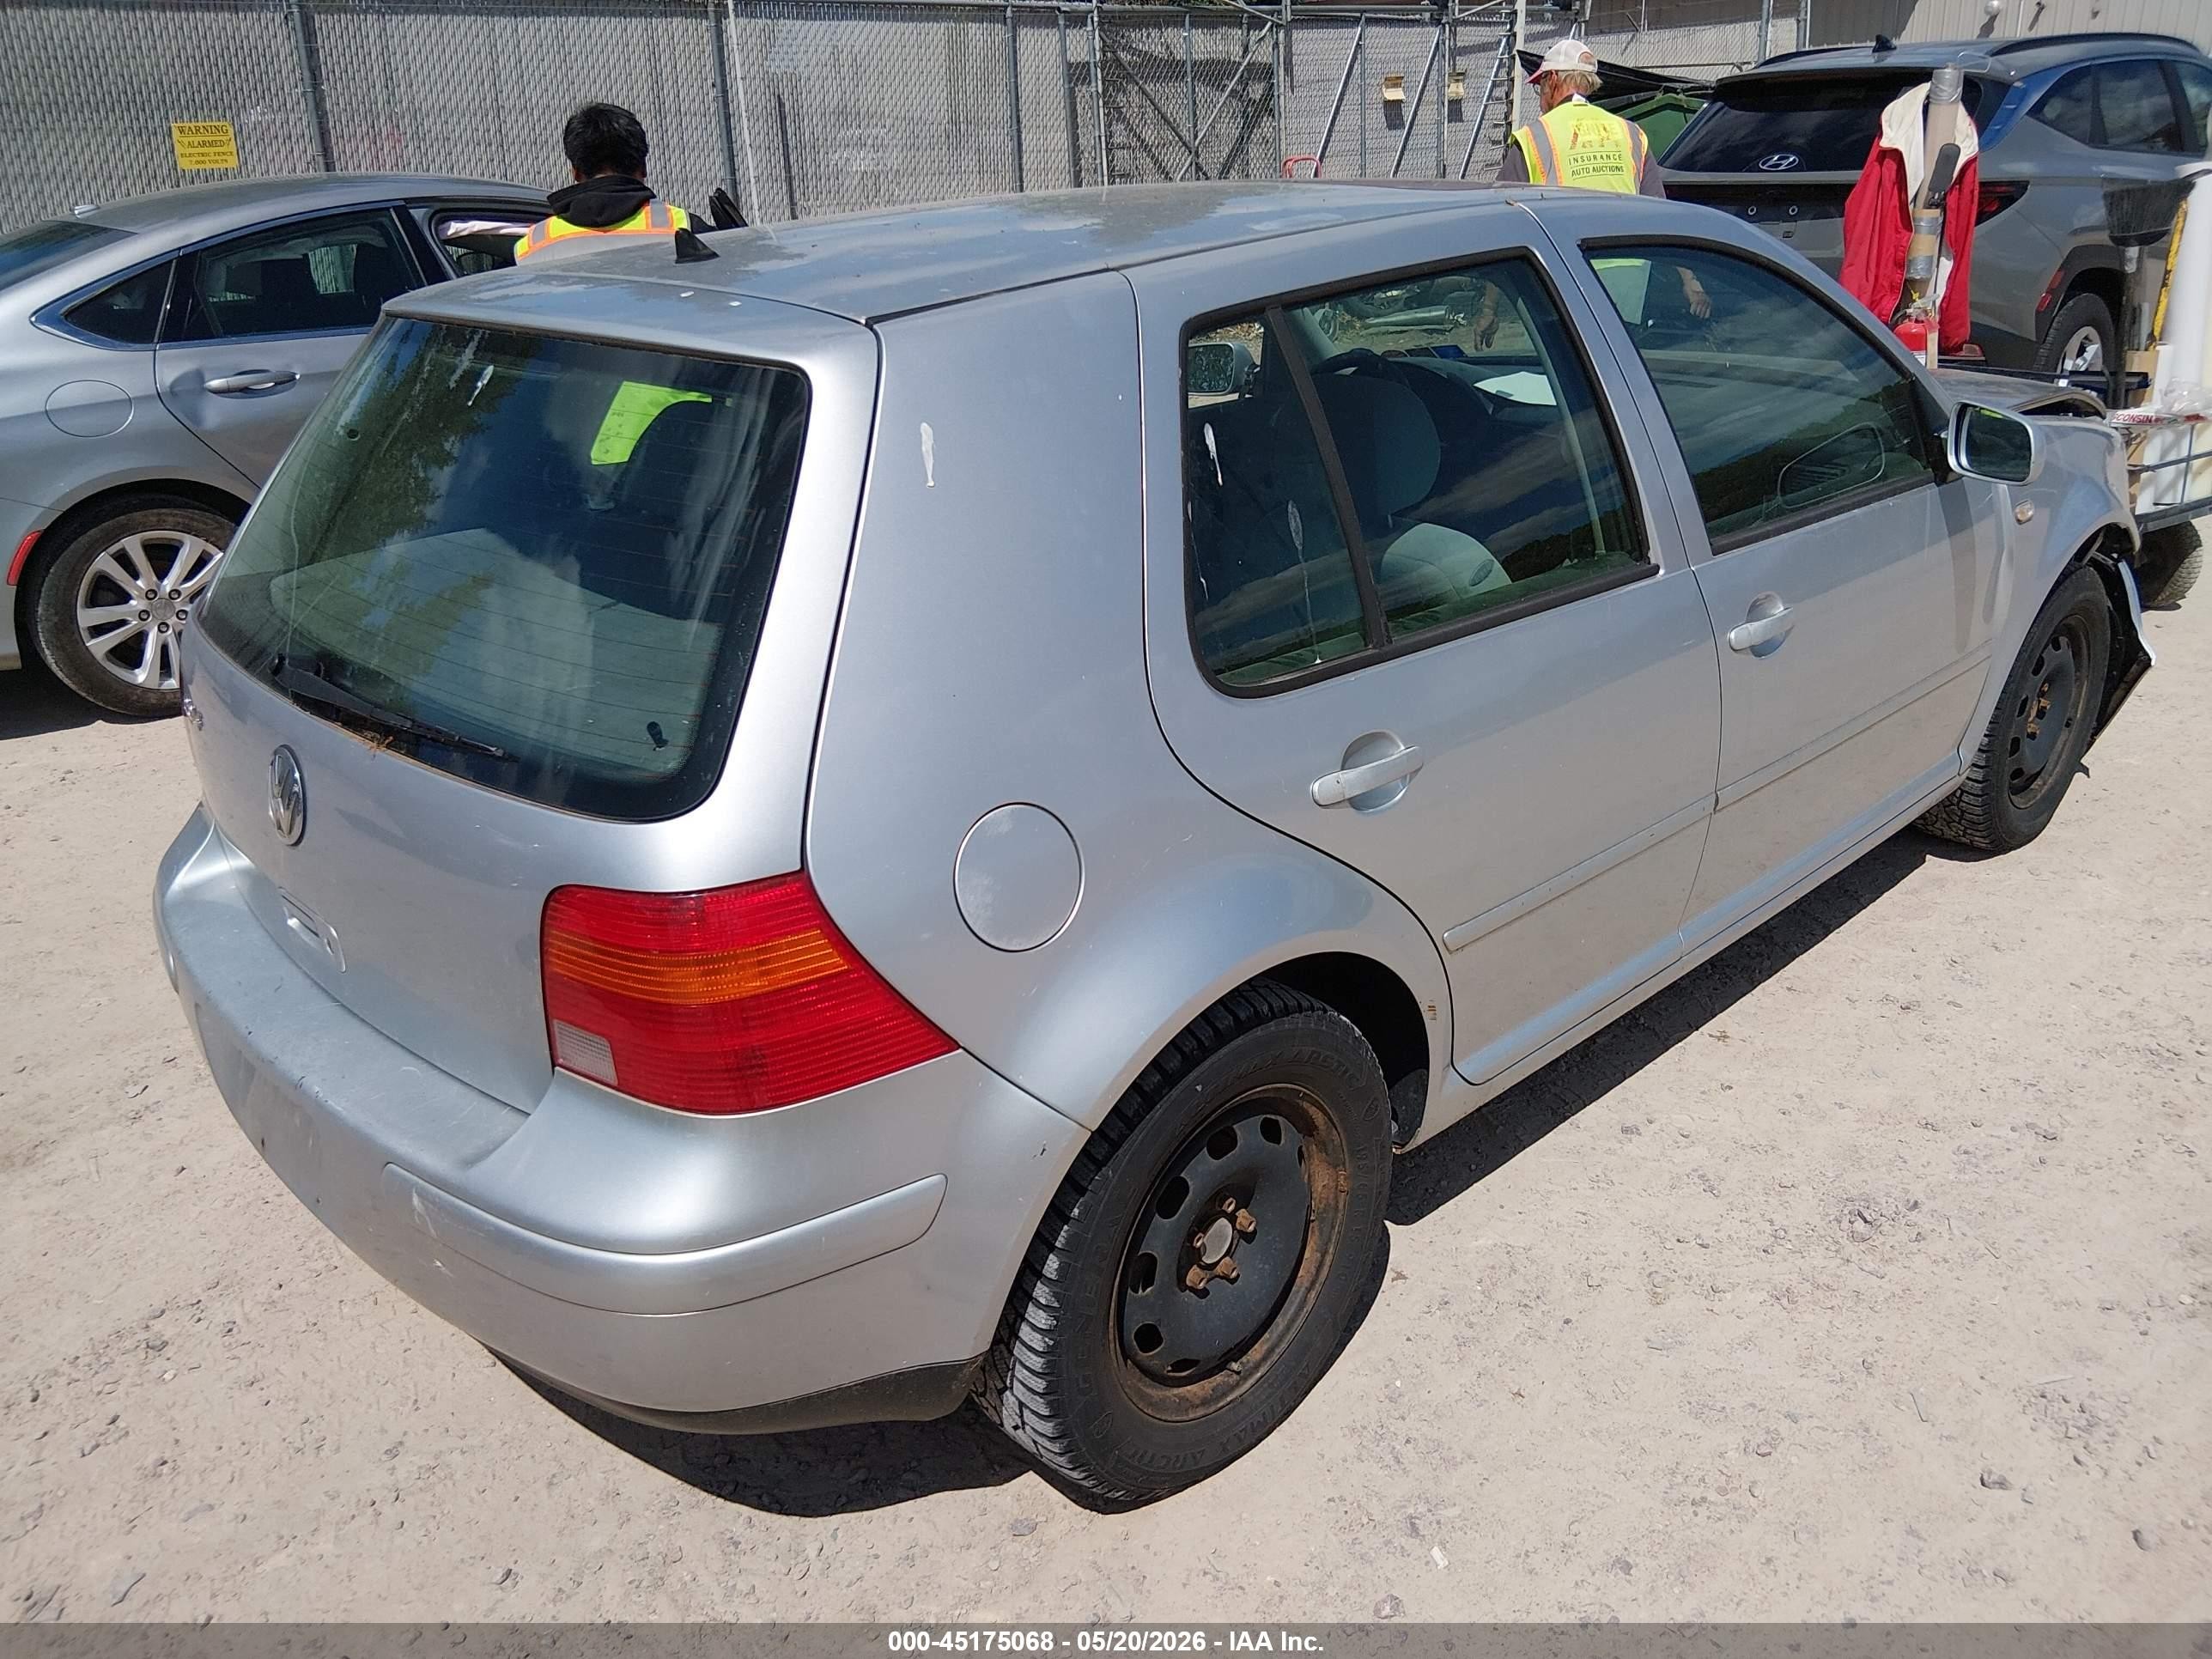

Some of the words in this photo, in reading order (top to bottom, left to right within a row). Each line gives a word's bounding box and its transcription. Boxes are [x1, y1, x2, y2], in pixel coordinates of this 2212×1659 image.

[177, 125, 228, 135] WARNING
[187, 139, 225, 149] ALARMED
[1568, 154, 1622, 166] INSURANCE
[1571, 167, 1590, 178] AUTO
[1592, 165, 1625, 173] AUCTIONS
